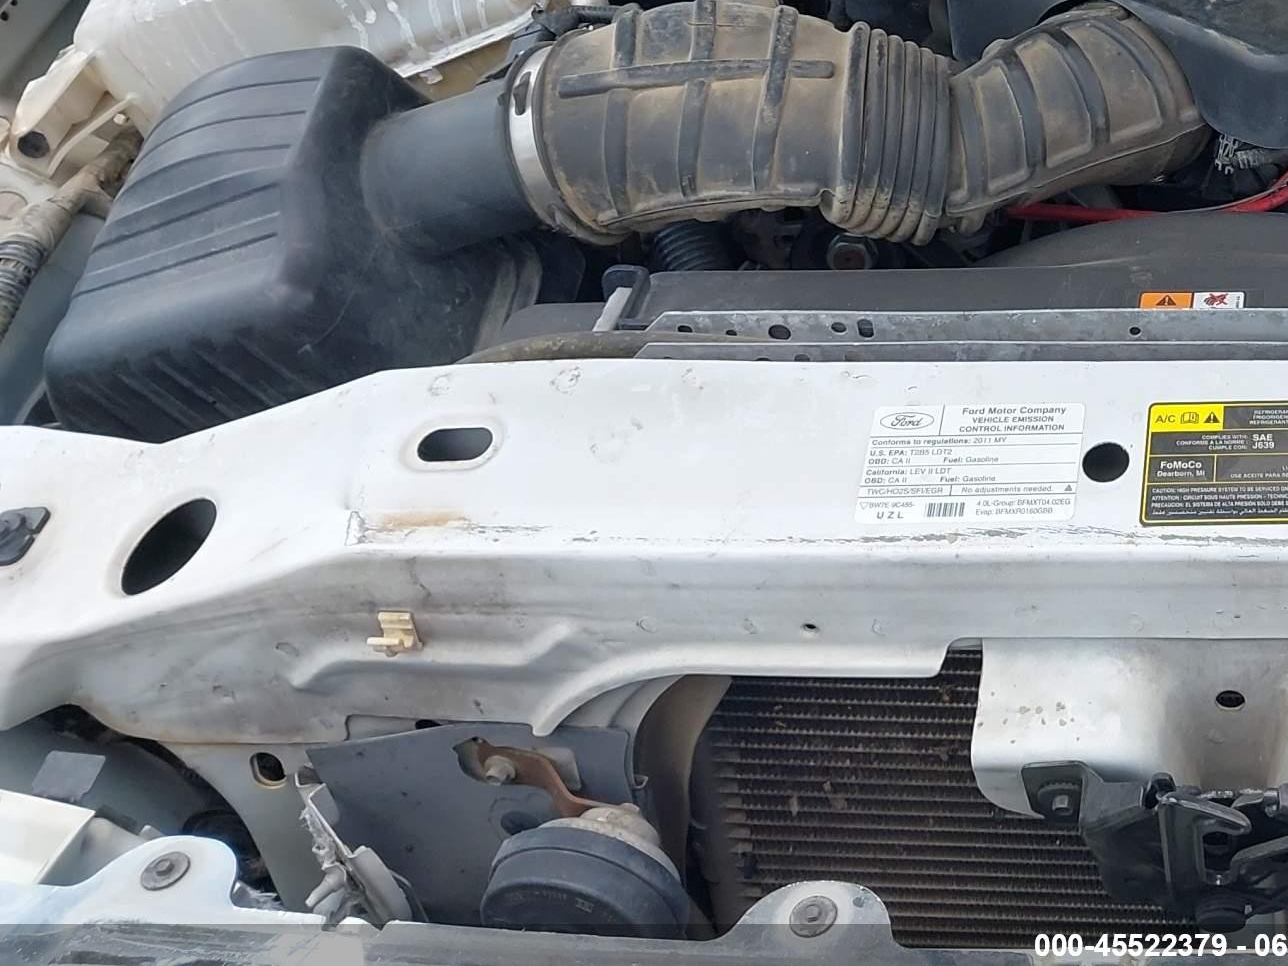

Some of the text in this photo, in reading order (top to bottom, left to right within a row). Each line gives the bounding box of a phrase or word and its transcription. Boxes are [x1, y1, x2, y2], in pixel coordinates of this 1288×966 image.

[962, 407, 985, 415] Ford
[1020, 406, 1067, 415] Company
[891, 415, 923, 427] Ford
[1155, 415, 1176, 423] A/C
[1004, 424, 1065, 432] INFORMATION
[923, 438, 971, 446] regulations:
[1252, 441, 1275, 449] J639
[1160, 461, 1202, 469] FoMoCo
[974, 486, 1021, 494] adjustments
